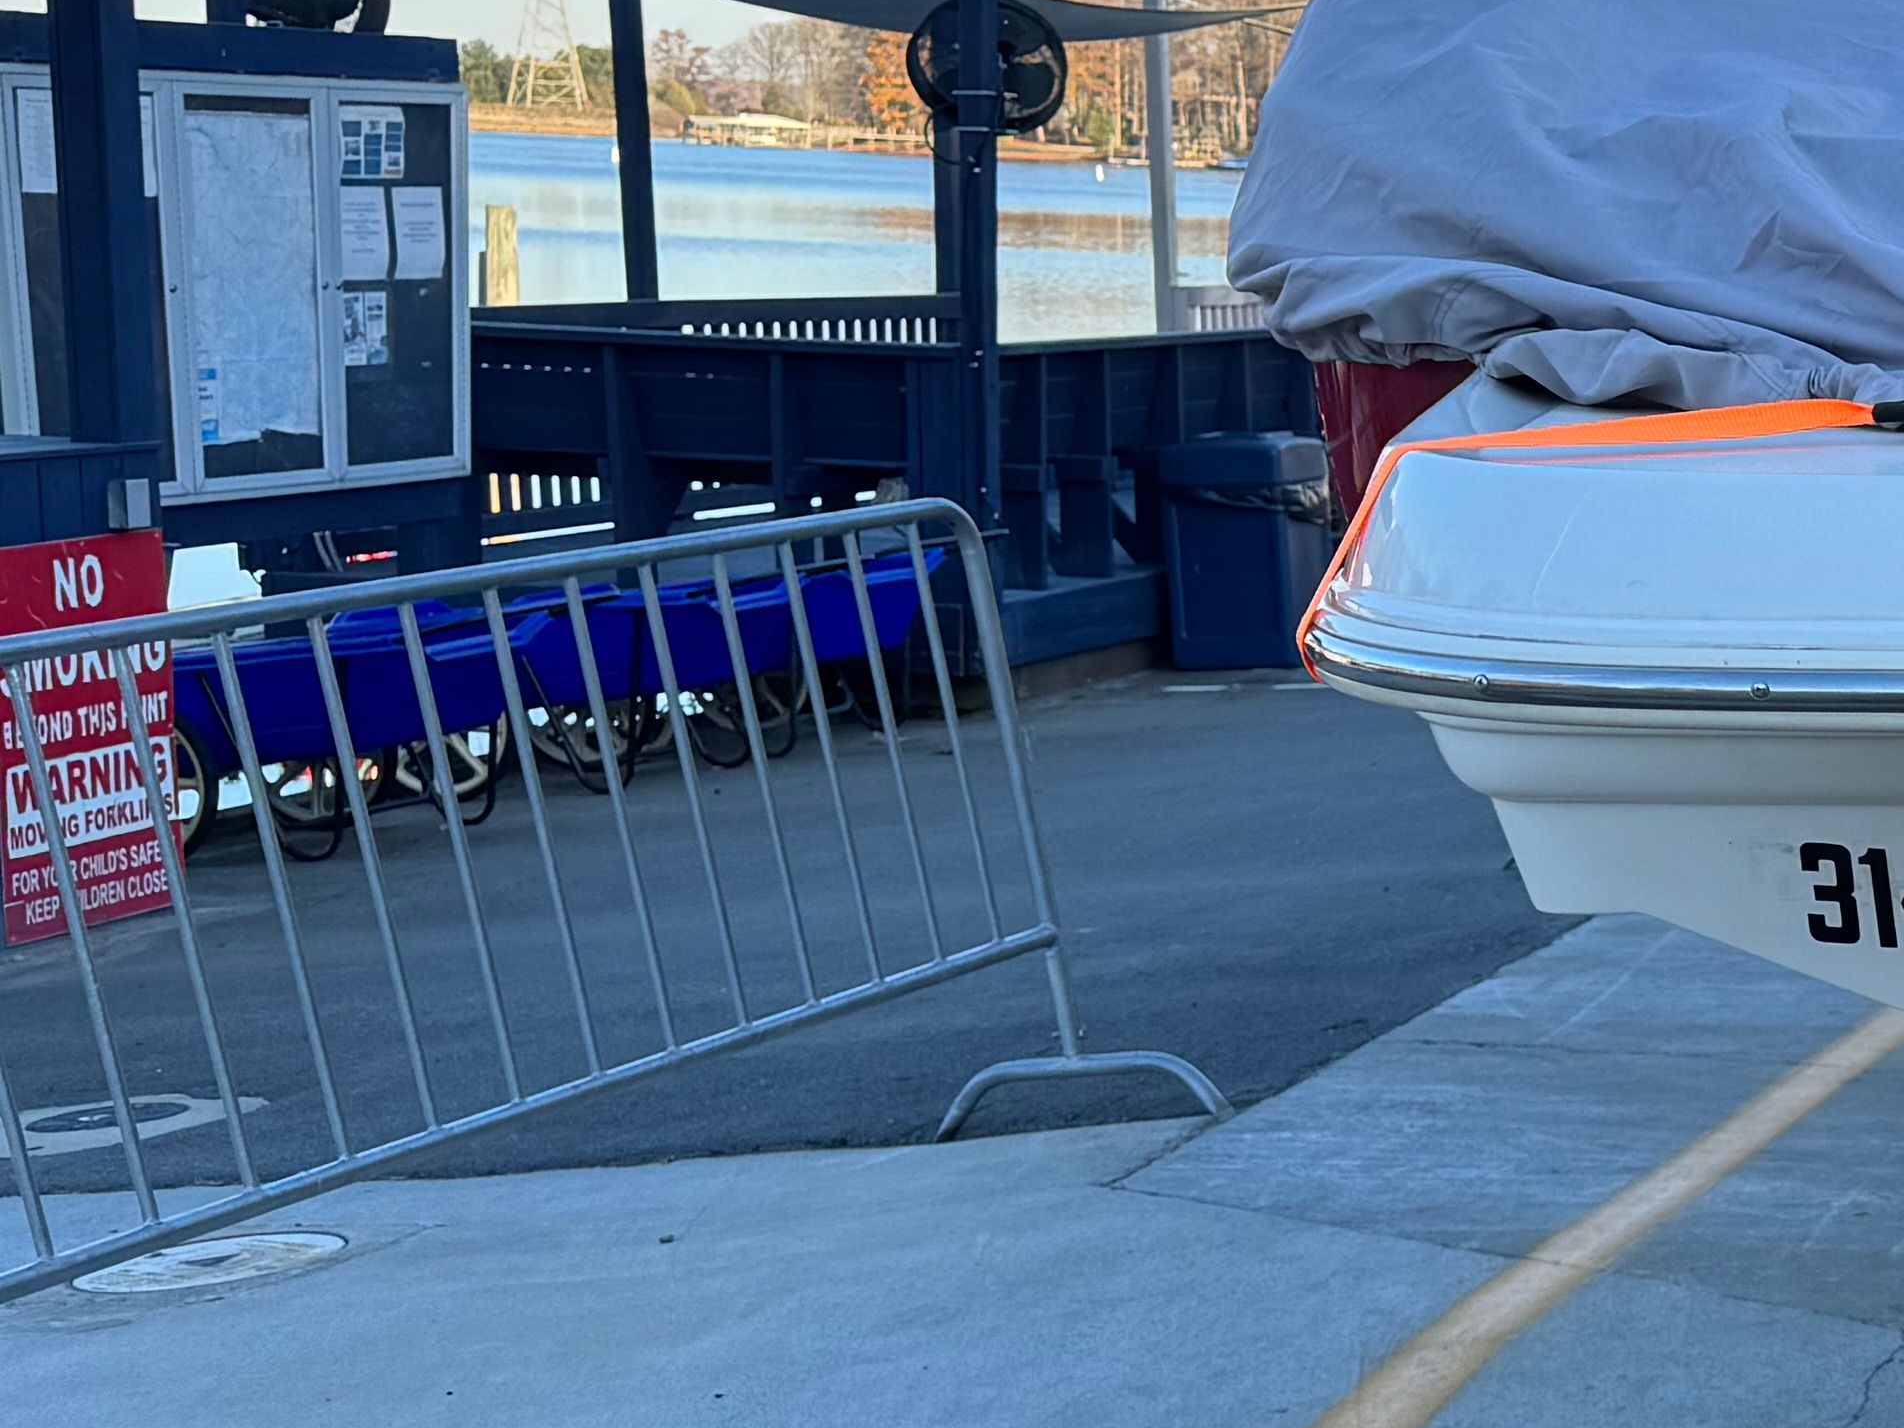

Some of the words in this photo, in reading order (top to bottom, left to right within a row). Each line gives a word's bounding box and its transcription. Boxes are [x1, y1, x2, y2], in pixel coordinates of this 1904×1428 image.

[53, 554, 104, 612] NO
[3, 710, 73, 749] BEOND
[77, 701, 117, 736] THIS
[11, 742, 168, 815] WARNING
[10, 815, 80, 850] MOVNG
[12, 868, 40, 897] FOR
[80, 847, 128, 880] CHILD'S
[25, 894, 60, 925] KEEP
[127, 868, 168, 899] CLOSE
